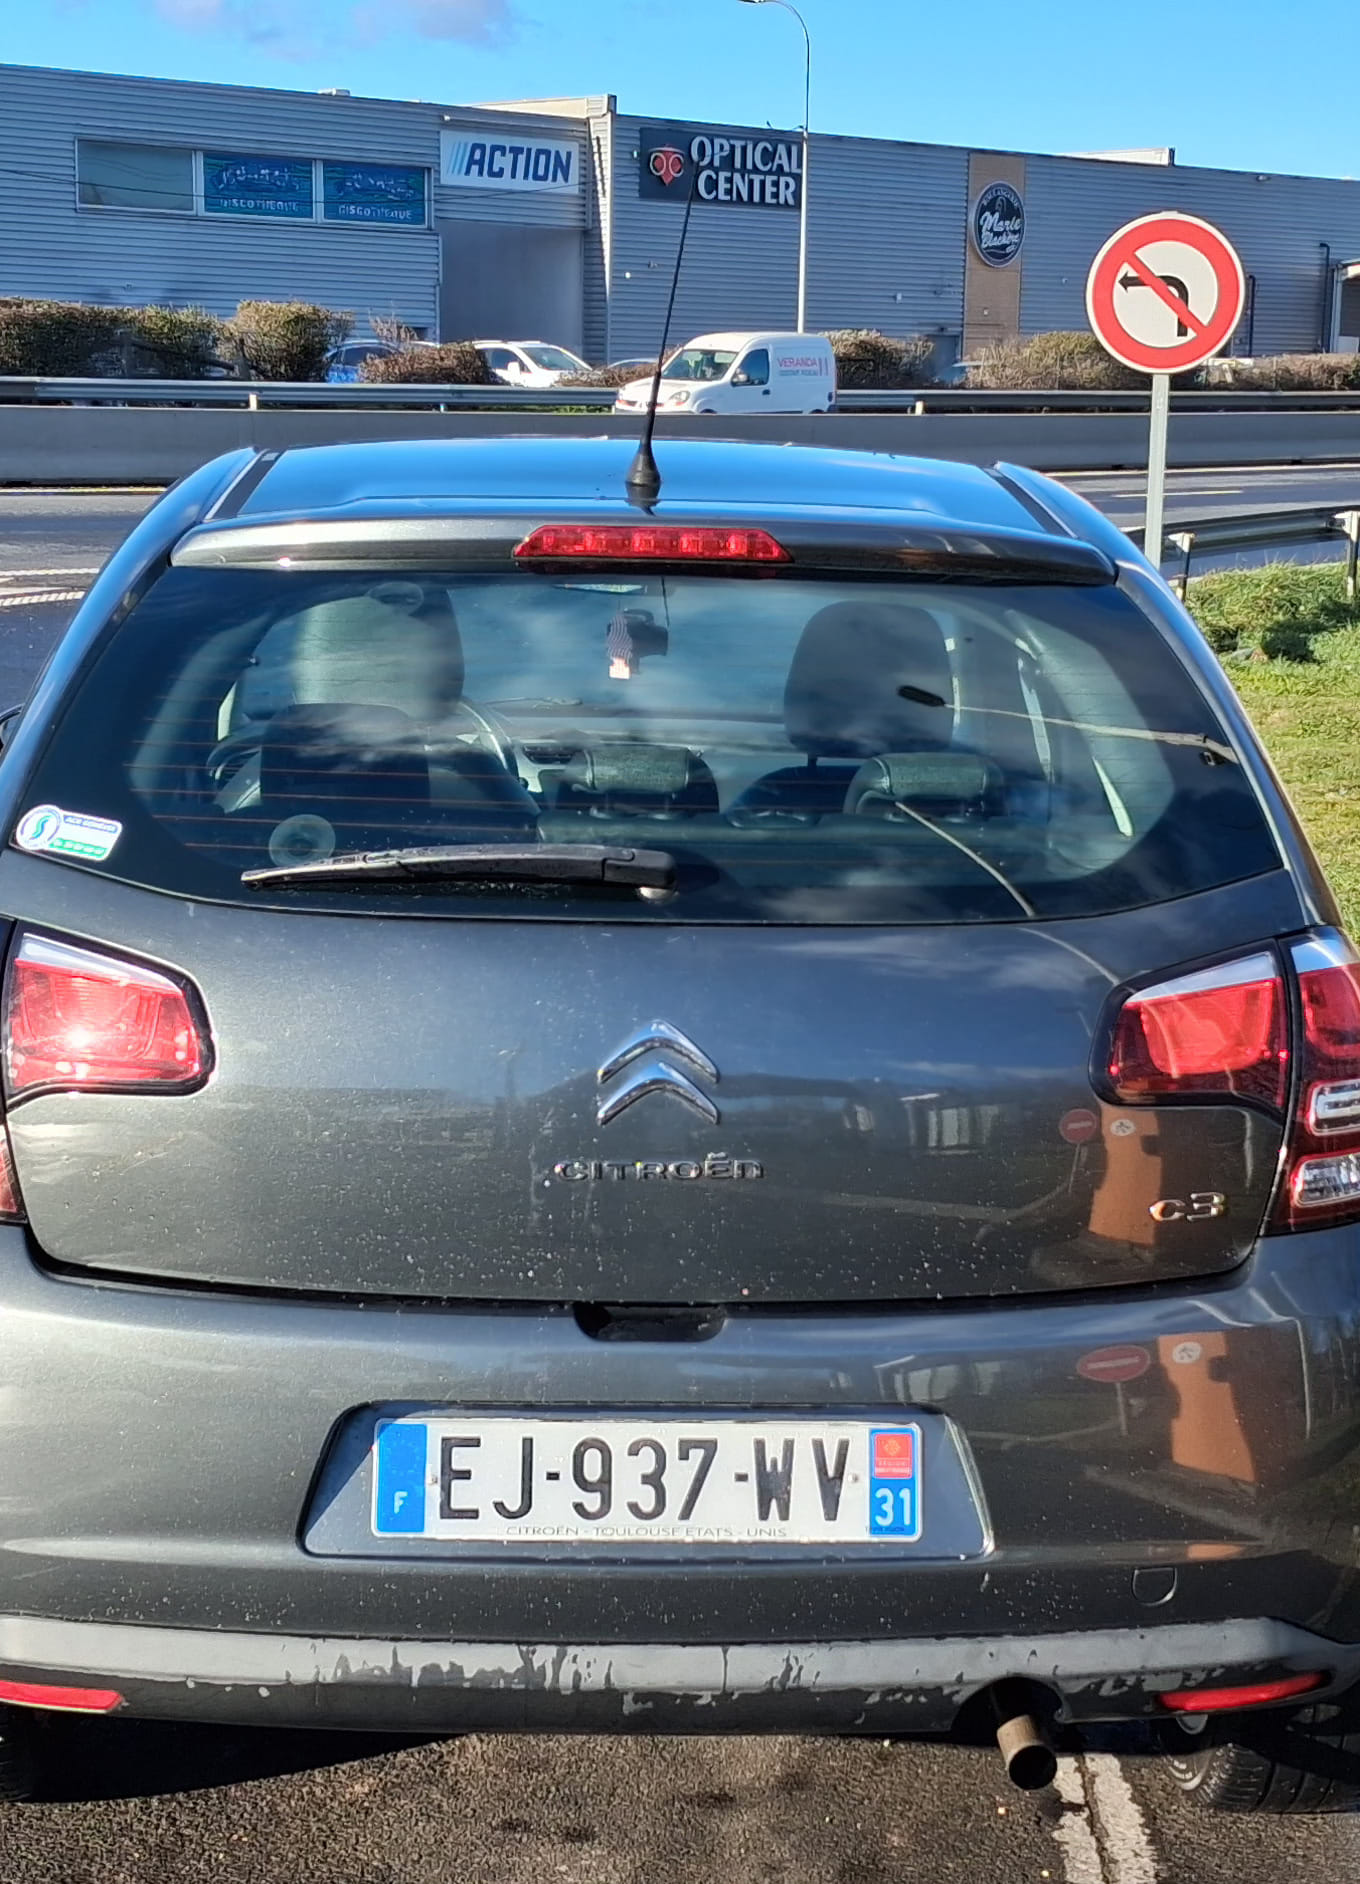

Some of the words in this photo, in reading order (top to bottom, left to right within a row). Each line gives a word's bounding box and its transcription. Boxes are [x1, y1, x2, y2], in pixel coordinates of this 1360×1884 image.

[464, 143, 572, 184] ACTION
[691, 136, 801, 174] OPTICAL
[698, 169, 796, 206] CENTER
[554, 1152, 764, 1181] CITROËN
[1149, 1191, 1225, 1222] C3
[439, 1436, 850, 1520] EJ-937-WV
[393, 1490, 409, 1514] F
[875, 1487, 911, 1526] 31
[746, 1526, 788, 1537] UNIS
